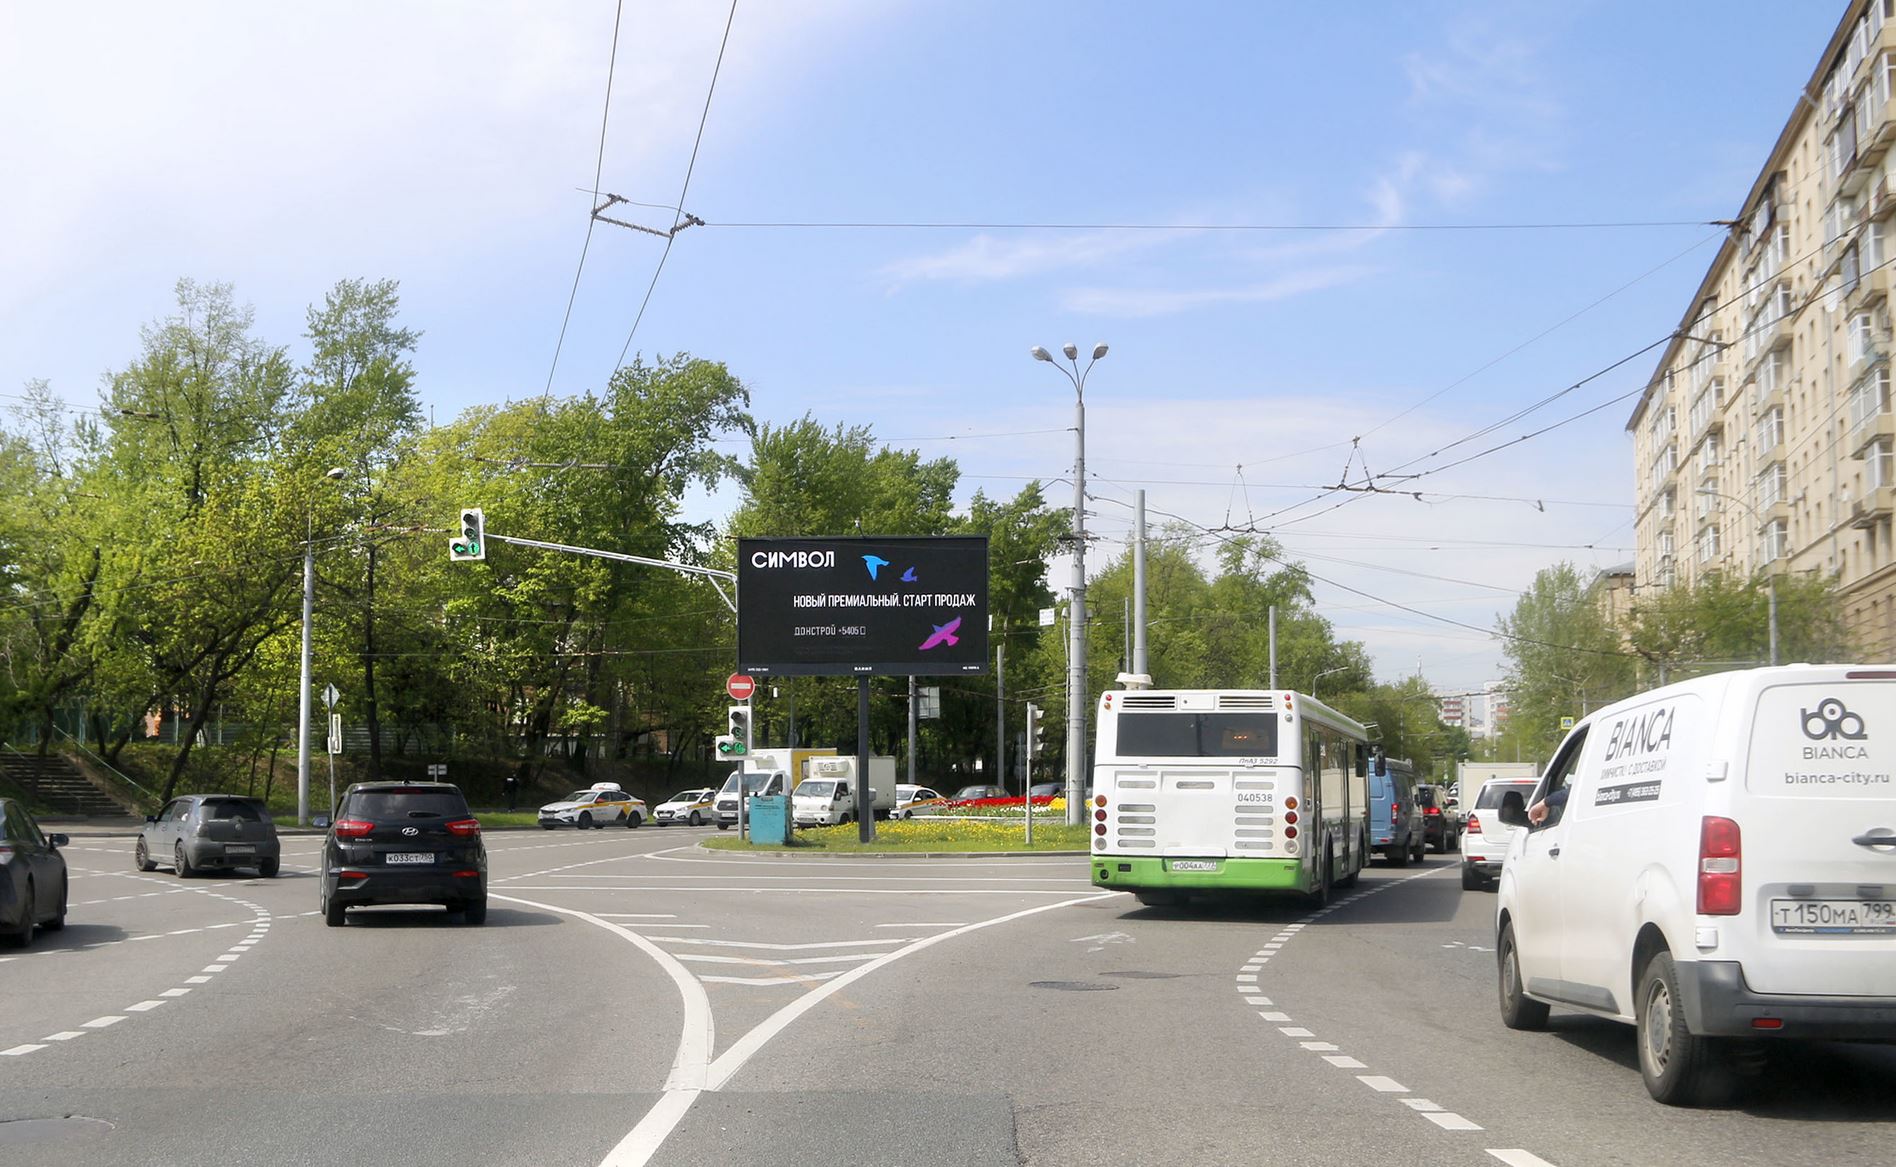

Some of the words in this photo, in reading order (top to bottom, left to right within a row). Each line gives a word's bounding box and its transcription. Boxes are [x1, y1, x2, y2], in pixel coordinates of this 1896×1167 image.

[751, 551, 835, 568] СИМВОЛ
[793, 592, 826, 608] НОВЫЙ
[828, 592, 901, 607] ПРЕМИАЛЬНЫЙ.
[903, 594, 933, 607] СТАРТ
[934, 594, 976, 608] ПРОДАЖ
[794, 624, 836, 636] ДОНСТРОЙ
[1605, 706, 1675, 762] BIANCA
[1803, 746, 1869, 760] BIANCA
[1785, 771, 1890, 786] bianca-city.ru
[1237, 793, 1273, 802] 040538
